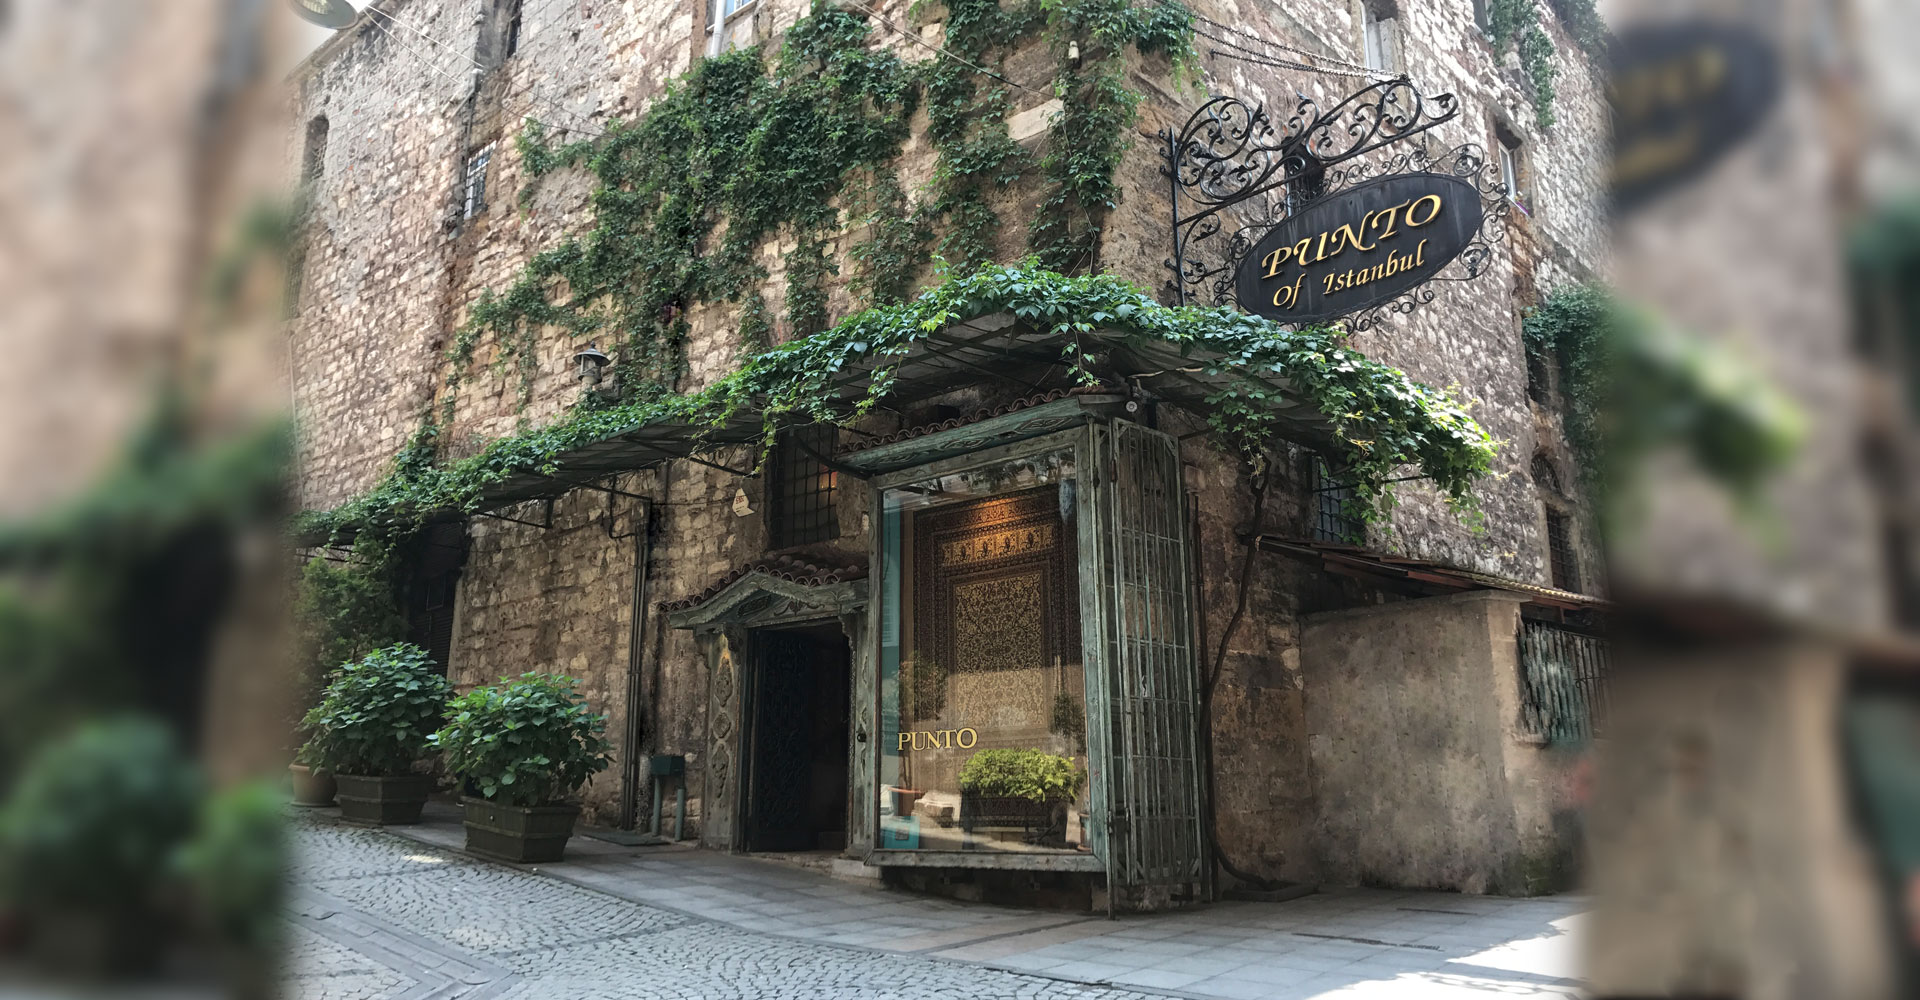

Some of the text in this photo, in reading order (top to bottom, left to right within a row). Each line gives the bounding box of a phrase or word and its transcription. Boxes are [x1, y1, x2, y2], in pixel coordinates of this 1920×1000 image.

[1261, 194, 1442, 280] PUNTO
[1272, 238, 1428, 310] Of Istanbul
[896, 727, 978, 751] PUNTO
